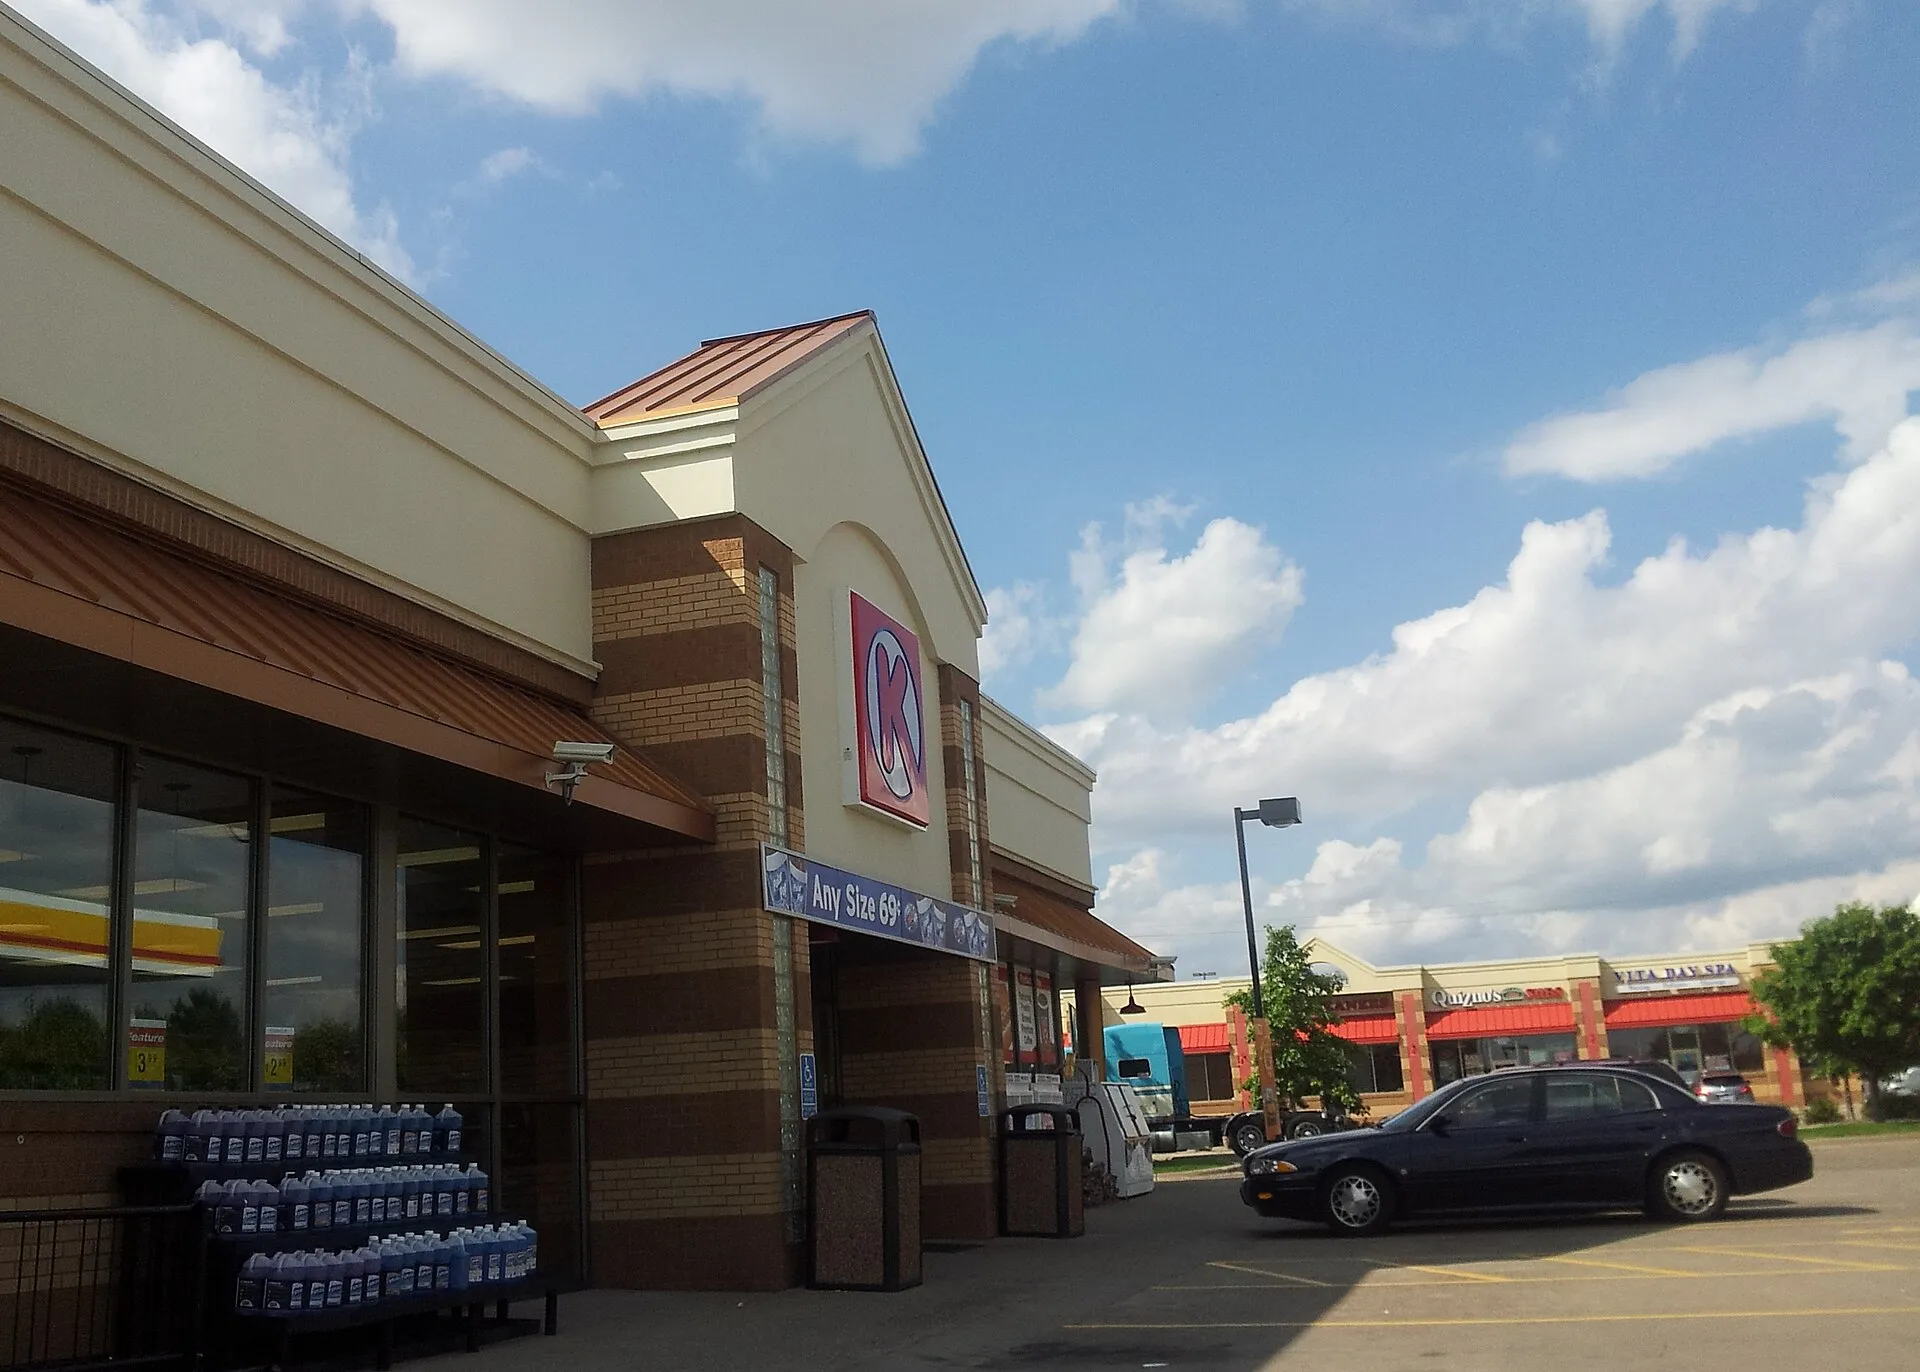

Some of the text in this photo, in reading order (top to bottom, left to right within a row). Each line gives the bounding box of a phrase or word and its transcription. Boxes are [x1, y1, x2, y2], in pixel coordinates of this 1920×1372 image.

[872, 638, 920, 798] K
[812, 873, 842, 922] Any
[845, 883, 876, 922] Size
[1614, 963, 1736, 984] VITA DAY SPA
[1431, 990, 1502, 1008] Quizno's
[263, 1039, 293, 1049] eature
